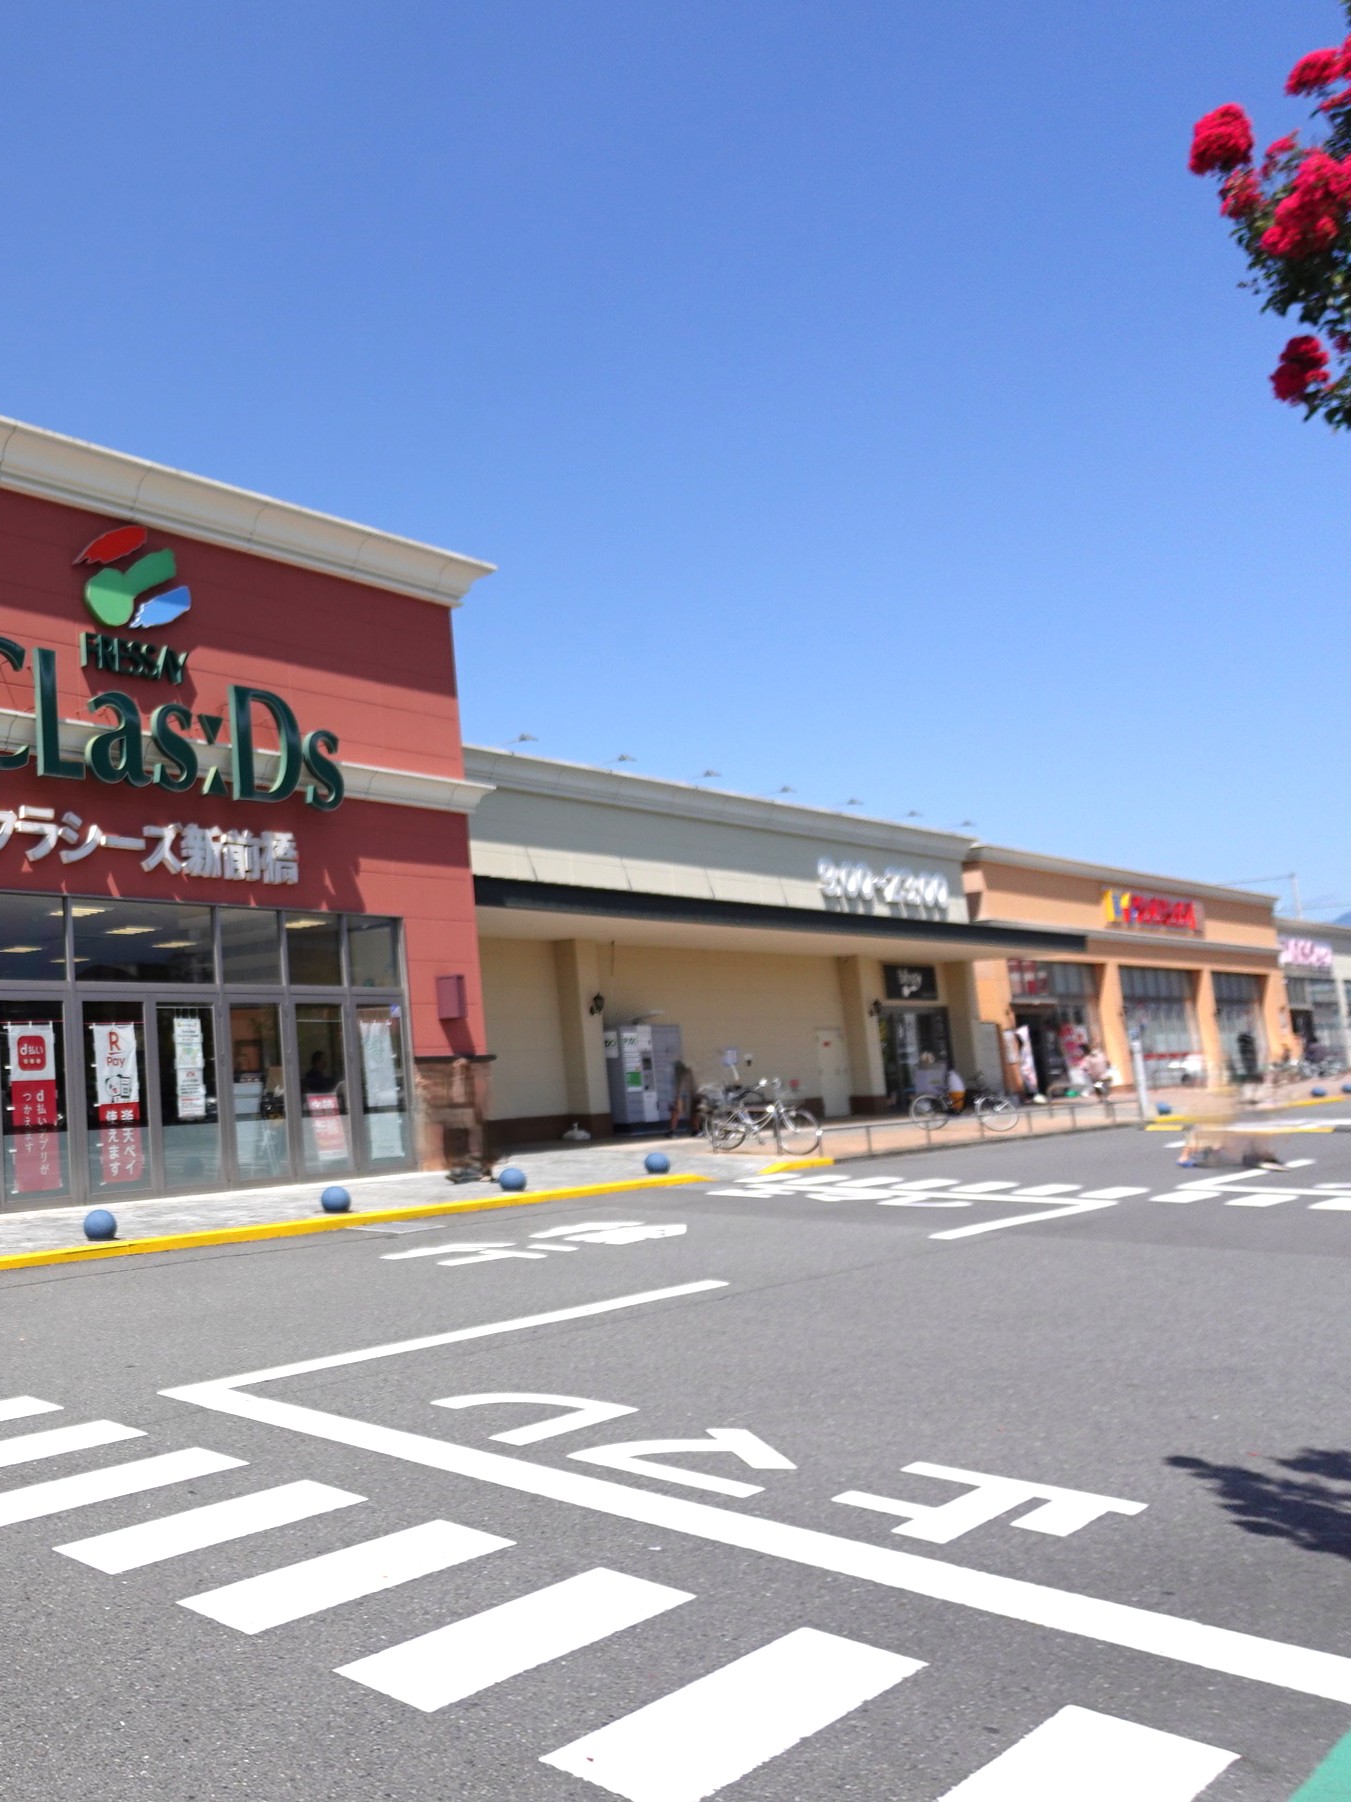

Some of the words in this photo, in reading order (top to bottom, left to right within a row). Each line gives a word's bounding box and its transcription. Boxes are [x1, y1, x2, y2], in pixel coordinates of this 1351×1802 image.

[80, 632, 189, 684] FRESSAY
[19, 1043, 44, 1056] d払い
[106, 1056, 126, 1068] Pay
